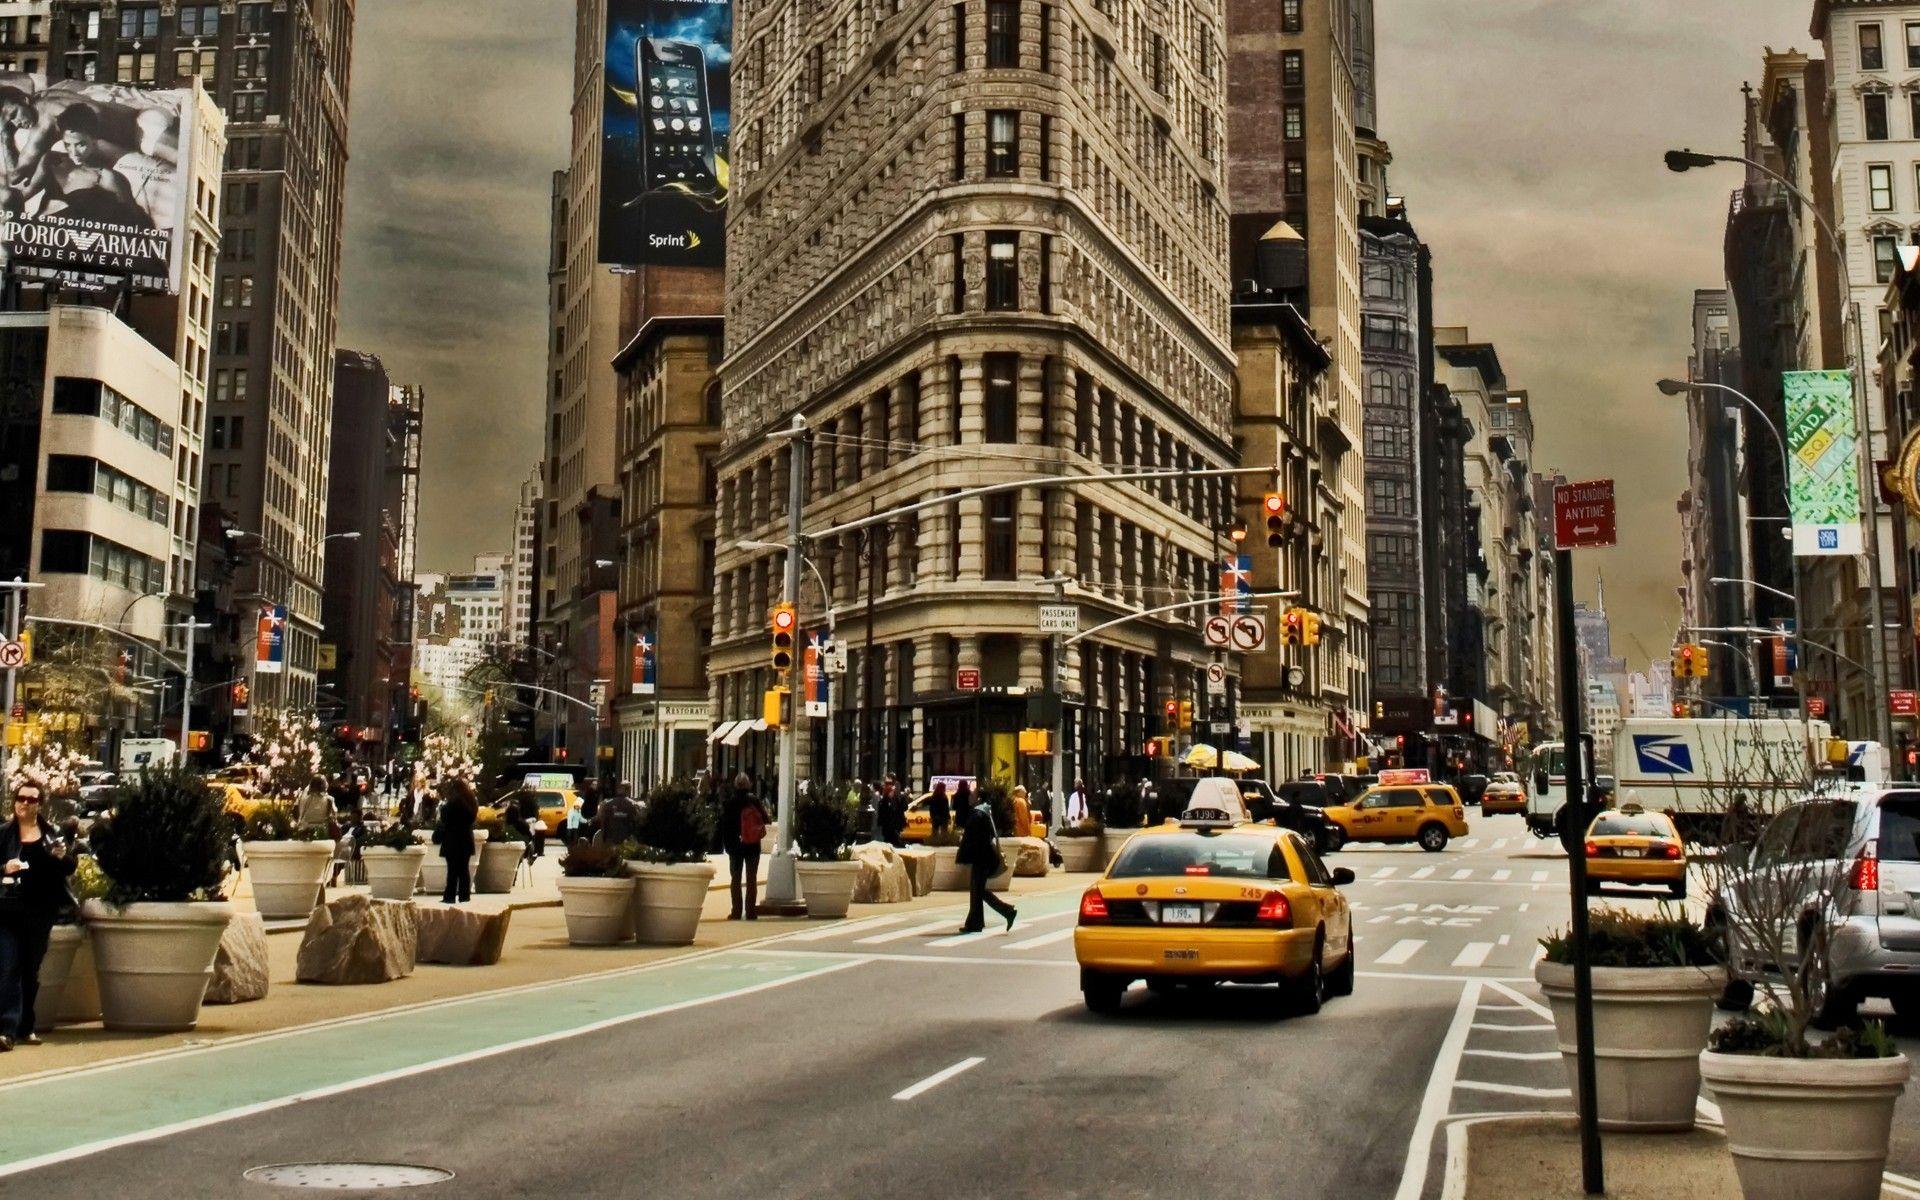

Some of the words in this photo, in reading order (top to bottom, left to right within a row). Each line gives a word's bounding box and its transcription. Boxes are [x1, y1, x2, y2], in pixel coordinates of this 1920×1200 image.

[39, 214, 169, 238] emporioarmani.com
[94, 235, 168, 260] ARMANI
[649, 234, 685, 248] Sprint
[14, 245, 133, 268] UNDERWEAR
[1788, 413, 1824, 448] MAD.
[1804, 438, 1829, 461] SQ.
[1558, 491, 1569, 504] NO
[1573, 487, 1610, 502] STANDING
[1566, 505, 1605, 520] ANYTIME
[1042, 609, 1076, 618] PASSENGER
[1042, 620, 1057, 628] CARS
[1061, 620, 1076, 628] ONLY
[1240, 887, 1262, 899] 245
[1365, 915, 1482, 927] IRE
